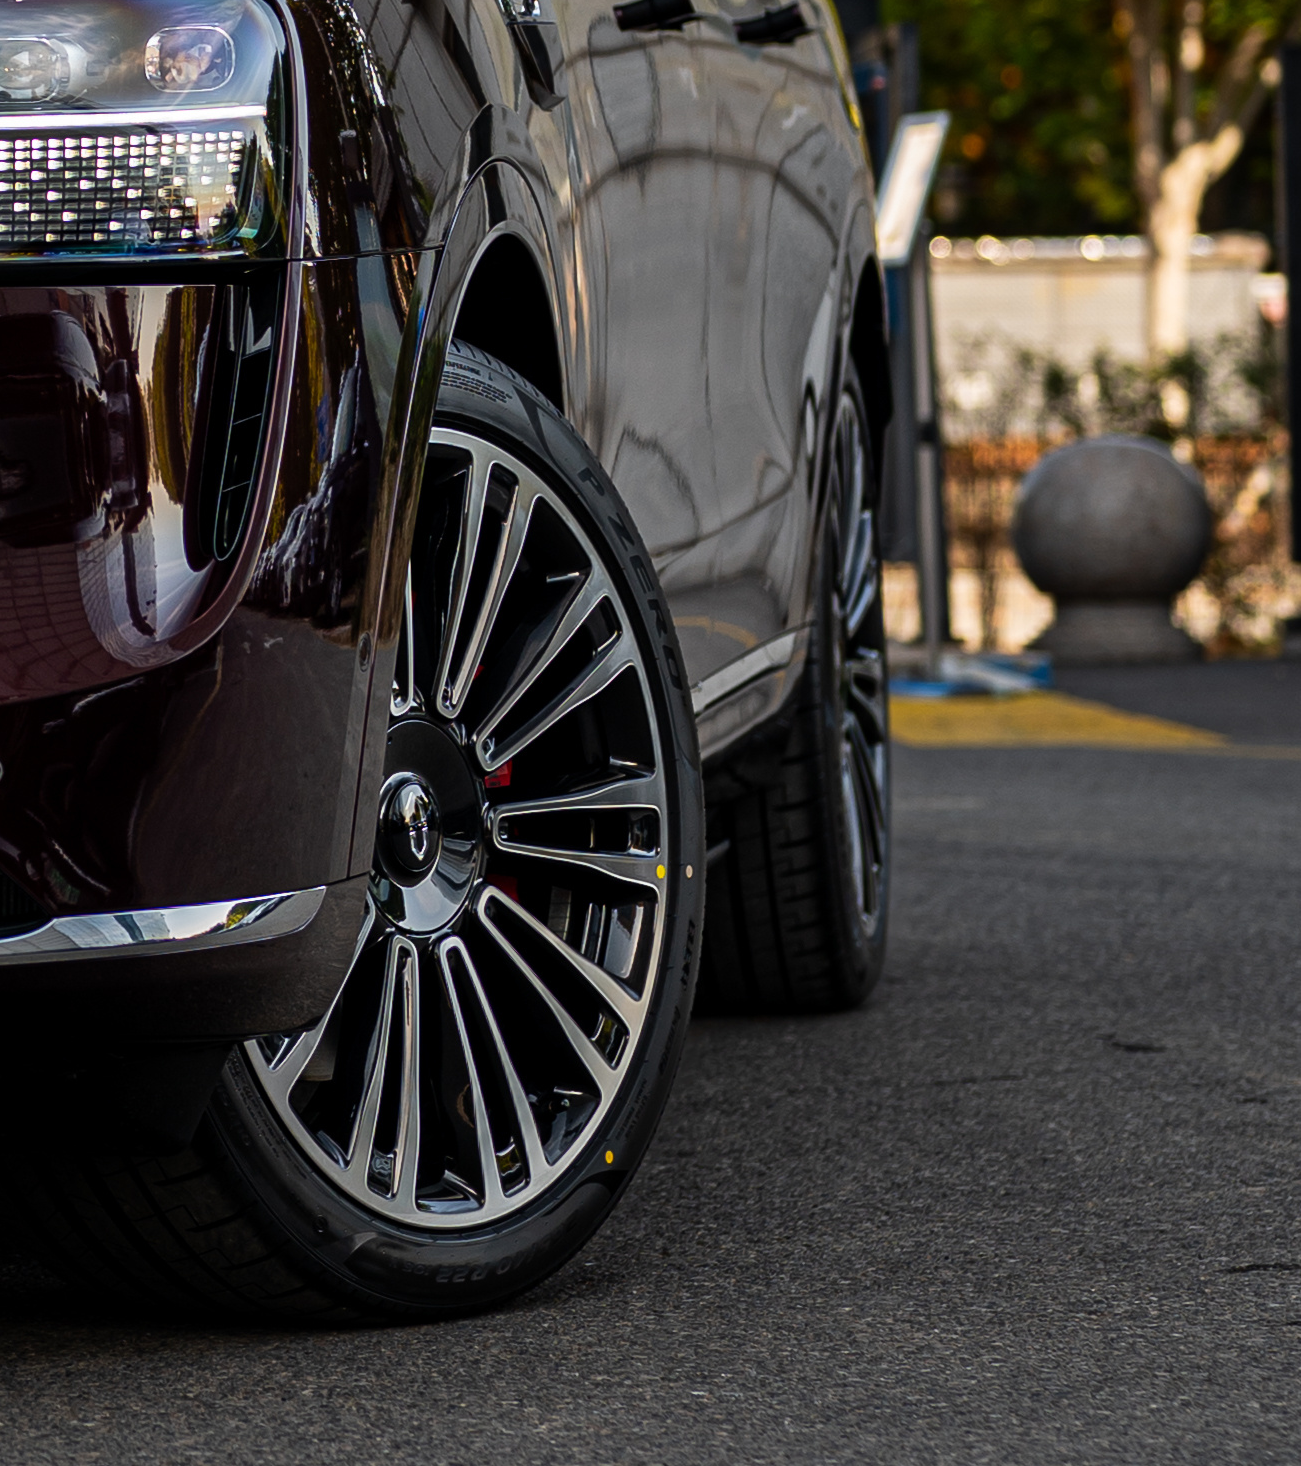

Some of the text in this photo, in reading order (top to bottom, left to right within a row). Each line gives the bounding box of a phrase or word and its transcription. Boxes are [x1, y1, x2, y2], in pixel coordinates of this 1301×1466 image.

[576, 467, 683, 692] P ZERO
[435, 1261, 490, 1283] R22
